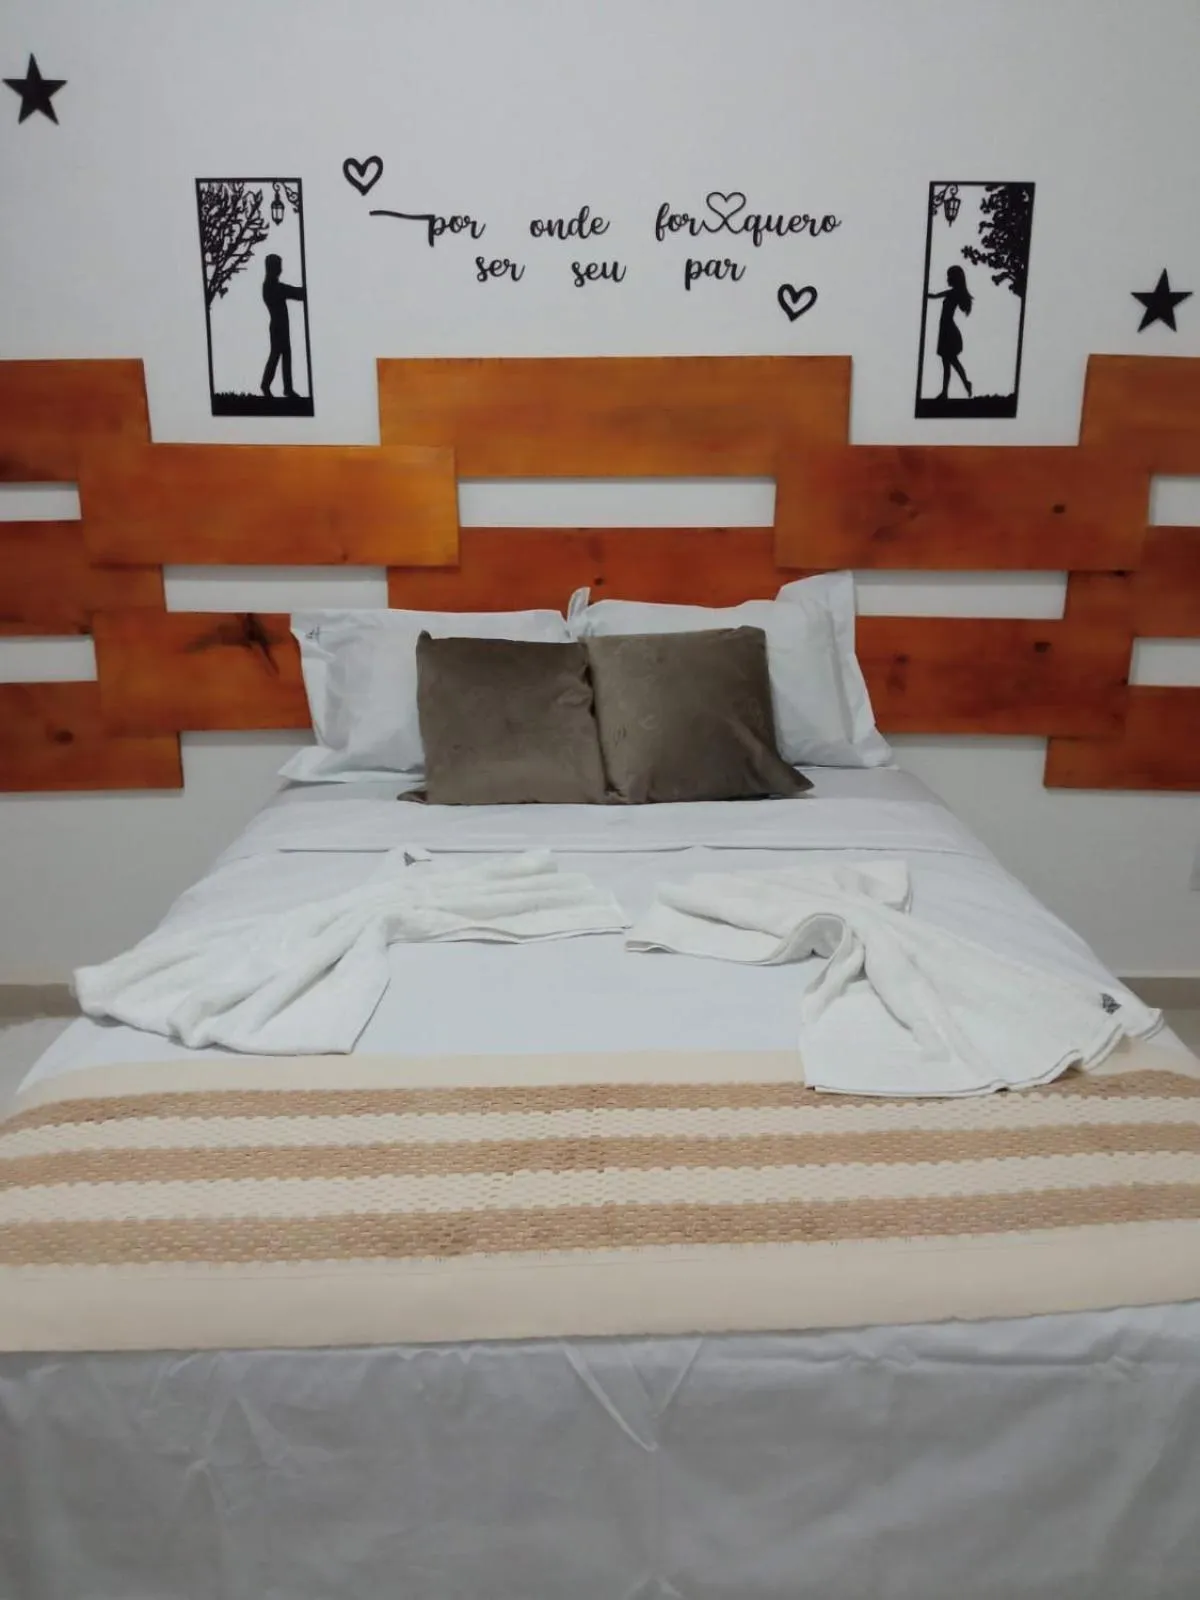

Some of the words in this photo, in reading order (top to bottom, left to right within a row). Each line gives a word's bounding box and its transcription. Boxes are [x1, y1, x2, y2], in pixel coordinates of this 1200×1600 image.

[422, 212, 486, 247] por
[529, 204, 610, 240] onde
[655, 202, 704, 241] for
[743, 214, 842, 247] quero
[475, 256, 525, 283] ser
[571, 260, 627, 288] seu
[684, 257, 746, 291] par
